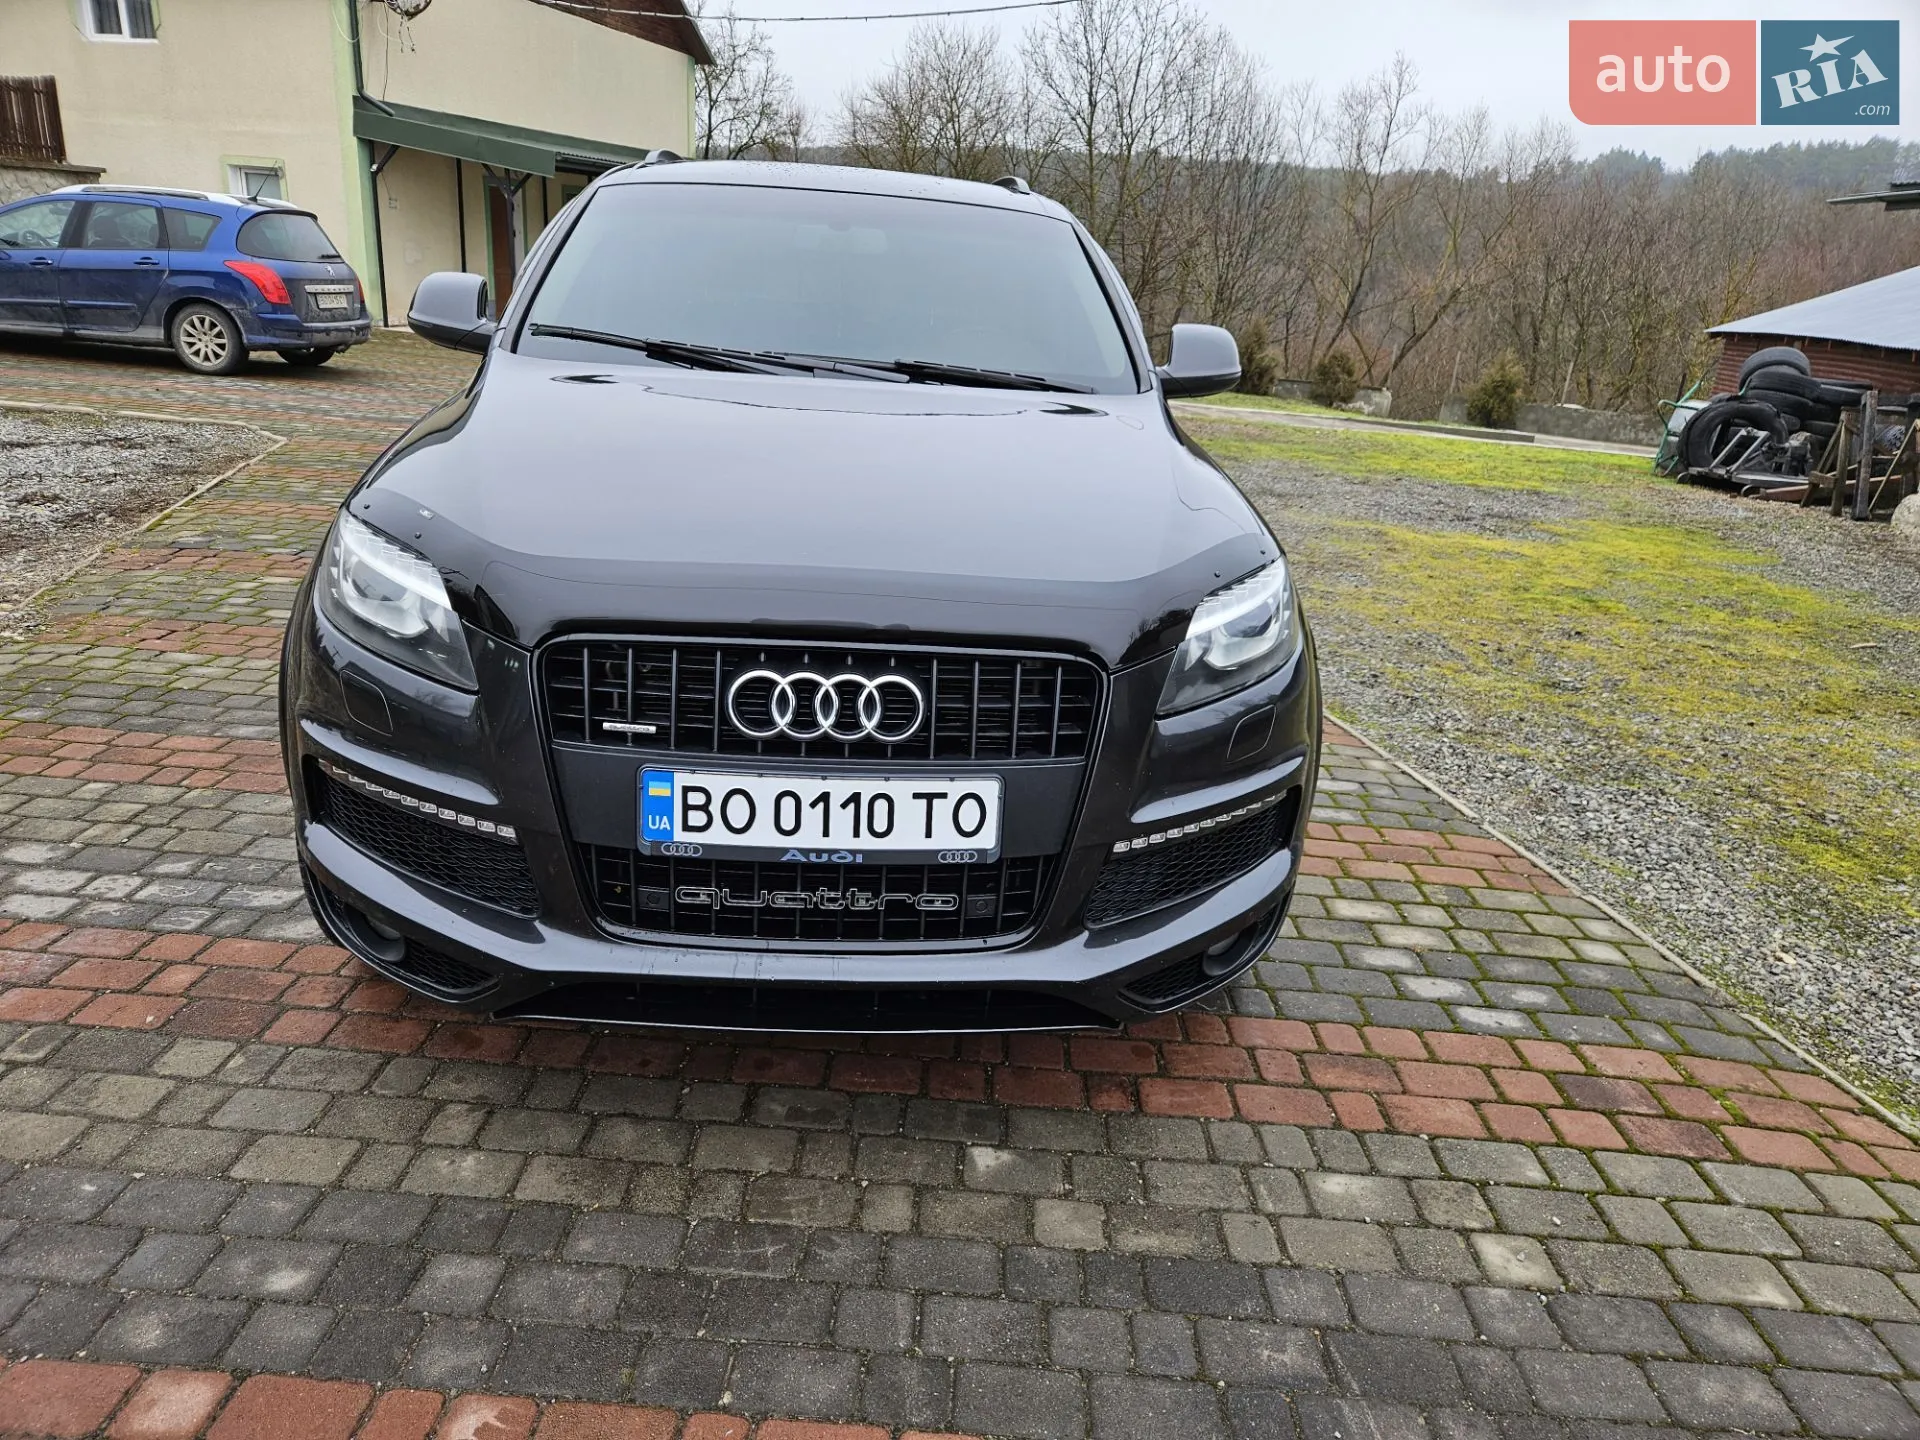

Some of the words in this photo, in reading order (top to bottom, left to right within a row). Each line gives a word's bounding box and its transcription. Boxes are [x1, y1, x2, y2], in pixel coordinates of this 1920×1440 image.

[648, 814, 671, 831] UA
[681, 785, 757, 835] BO
[773, 789, 895, 839] 0110
[912, 792, 987, 839] TO
[675, 886, 959, 911] quattro
